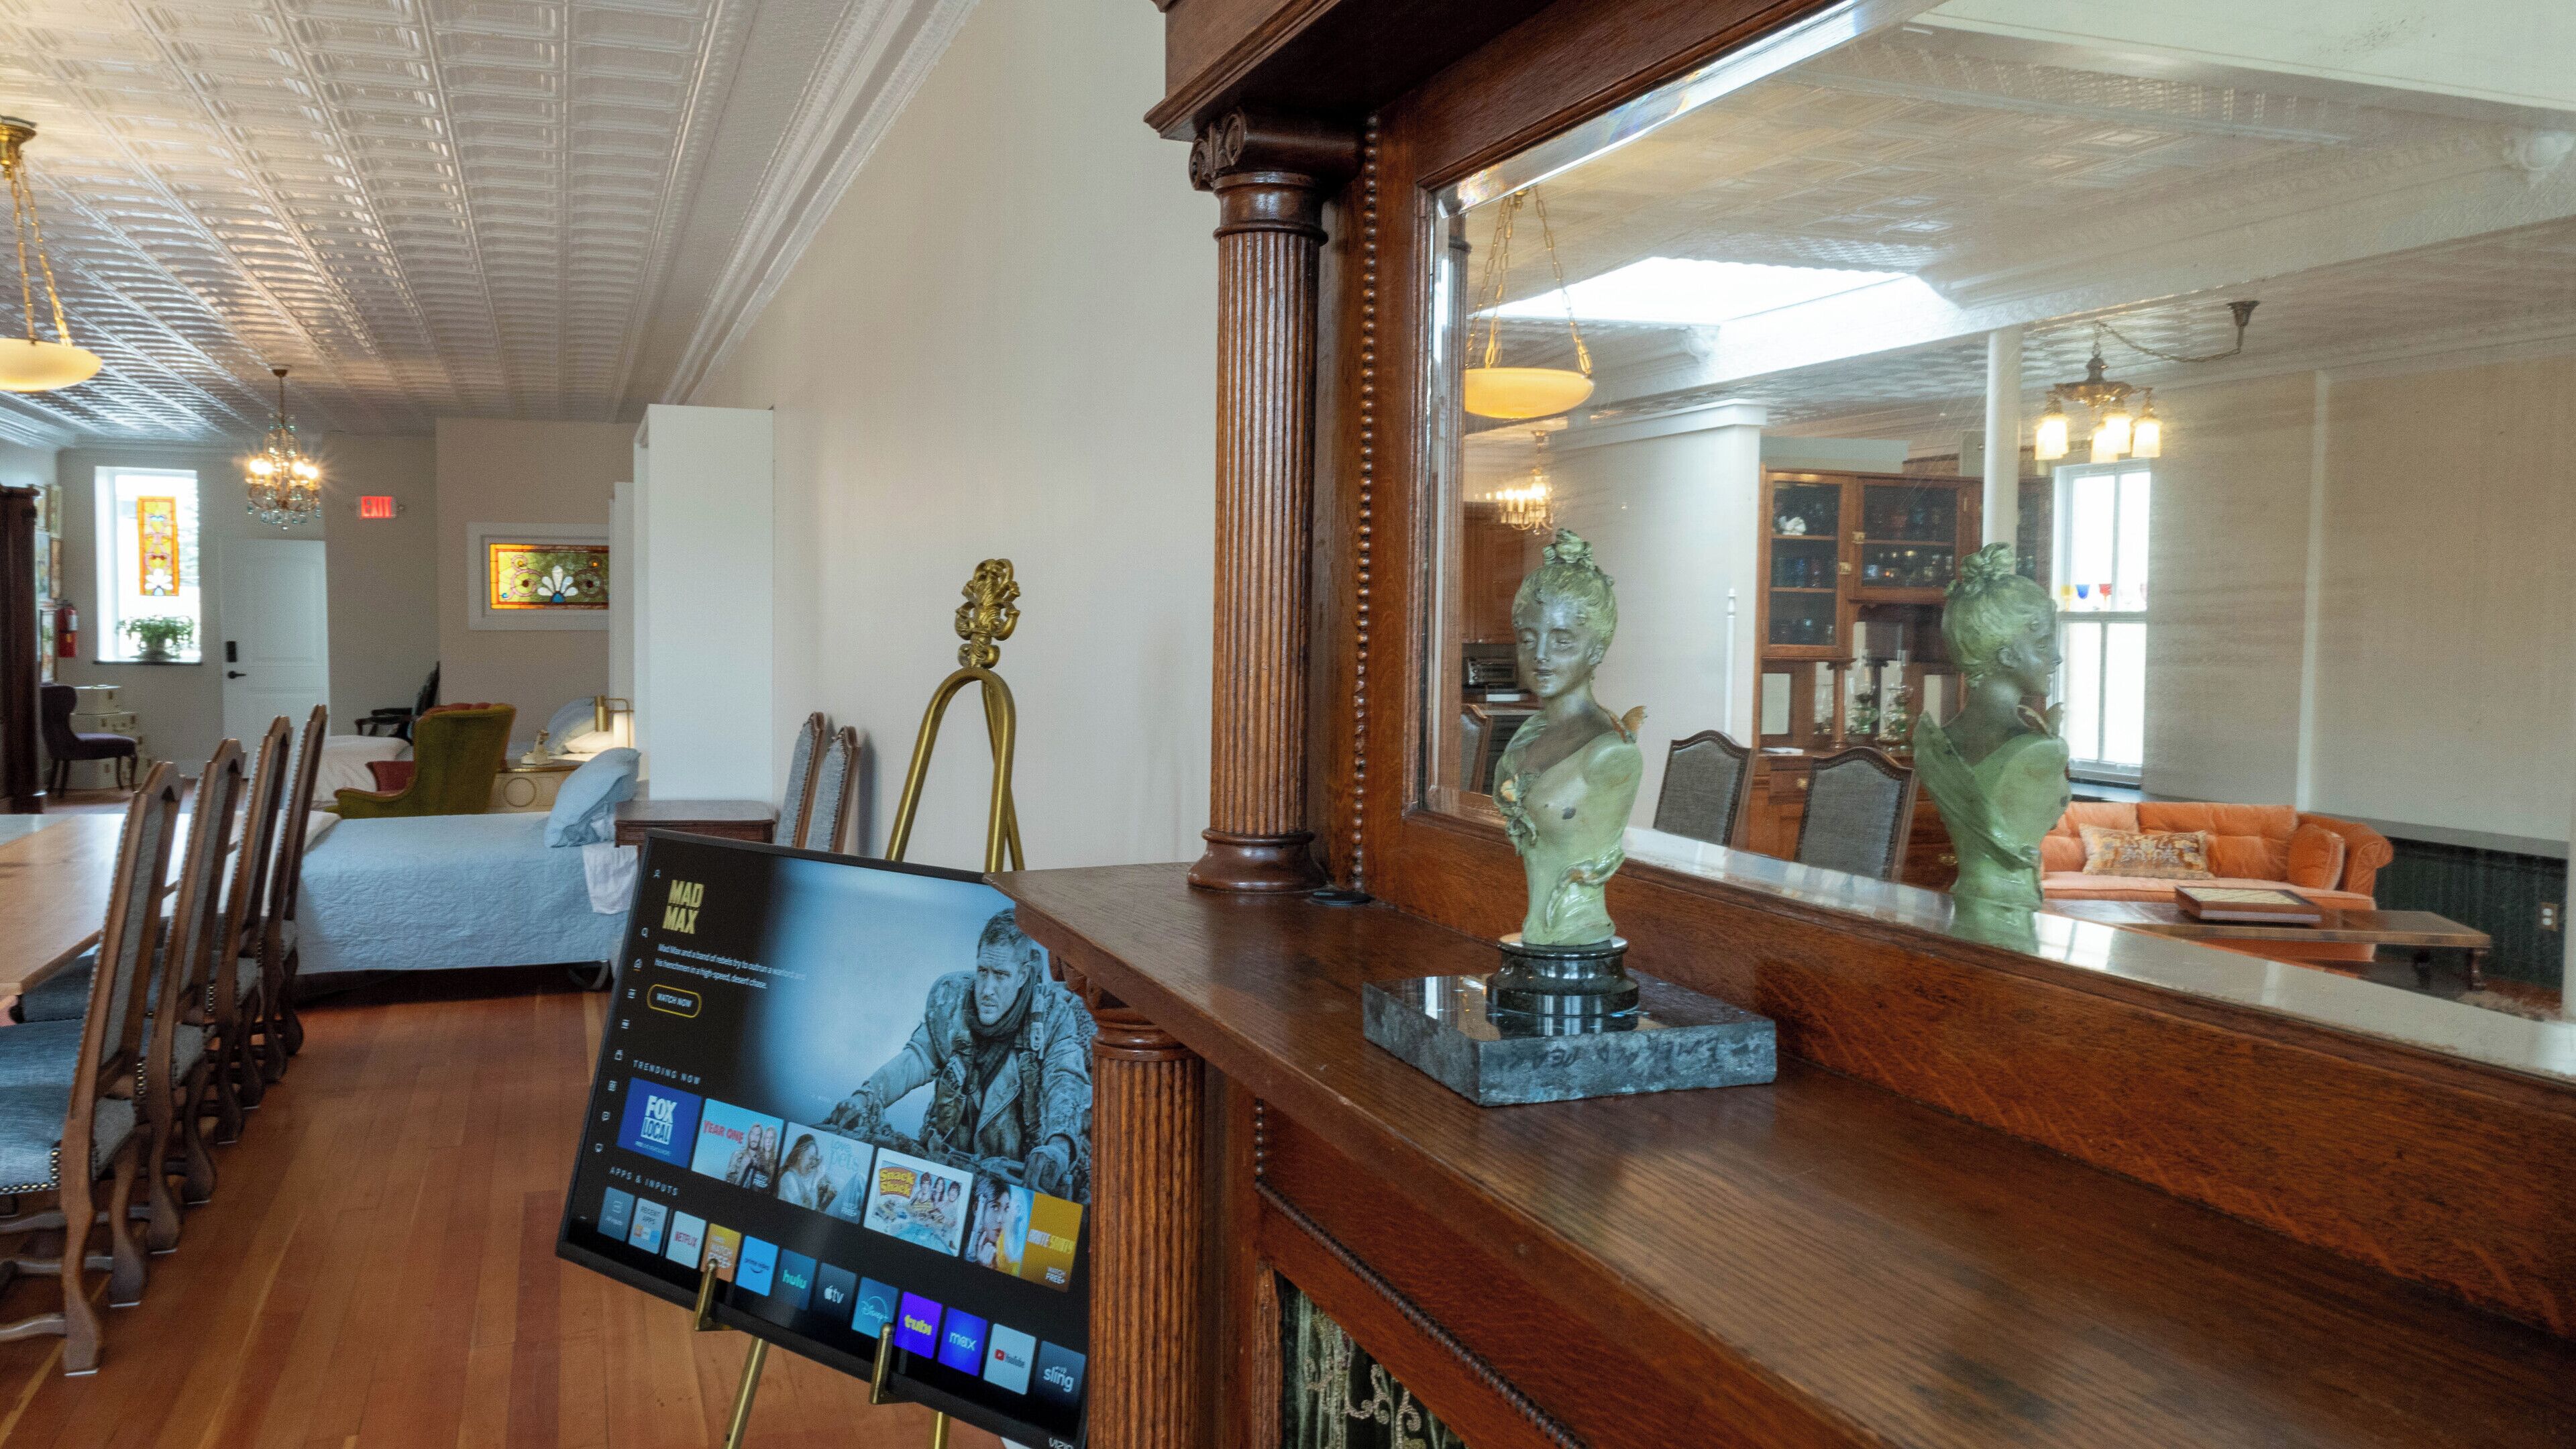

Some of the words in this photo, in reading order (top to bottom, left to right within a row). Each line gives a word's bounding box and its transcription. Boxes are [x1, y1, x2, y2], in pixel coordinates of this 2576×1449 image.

[362, 496, 392, 518] EXIT
[669, 879, 704, 907] MAD
[662, 906, 699, 933] MAX
[633, 1060, 678, 1079] TRENDING
[680, 1073, 701, 1085] NOW
[645, 1095, 678, 1123] FOX
[642, 1118, 672, 1143] LOCAL
[702, 1120, 726, 1137] YEAR
[726, 1127, 745, 1144] ONE
[609, 1166, 633, 1181] APPS
[635, 1175, 642, 1183] &
[645, 1178, 679, 1196] INPUTS
[879, 1169, 916, 1186] Snack
[674, 1231, 698, 1249] NETFLIX
[782, 1269, 808, 1289] hulu
[831, 1288, 845, 1303] tv
[904, 1314, 932, 1336] tubi
[949, 1331, 977, 1352] max
[1005, 1352, 1026, 1369] YouTube
[1043, 1366, 1075, 1393] sling
